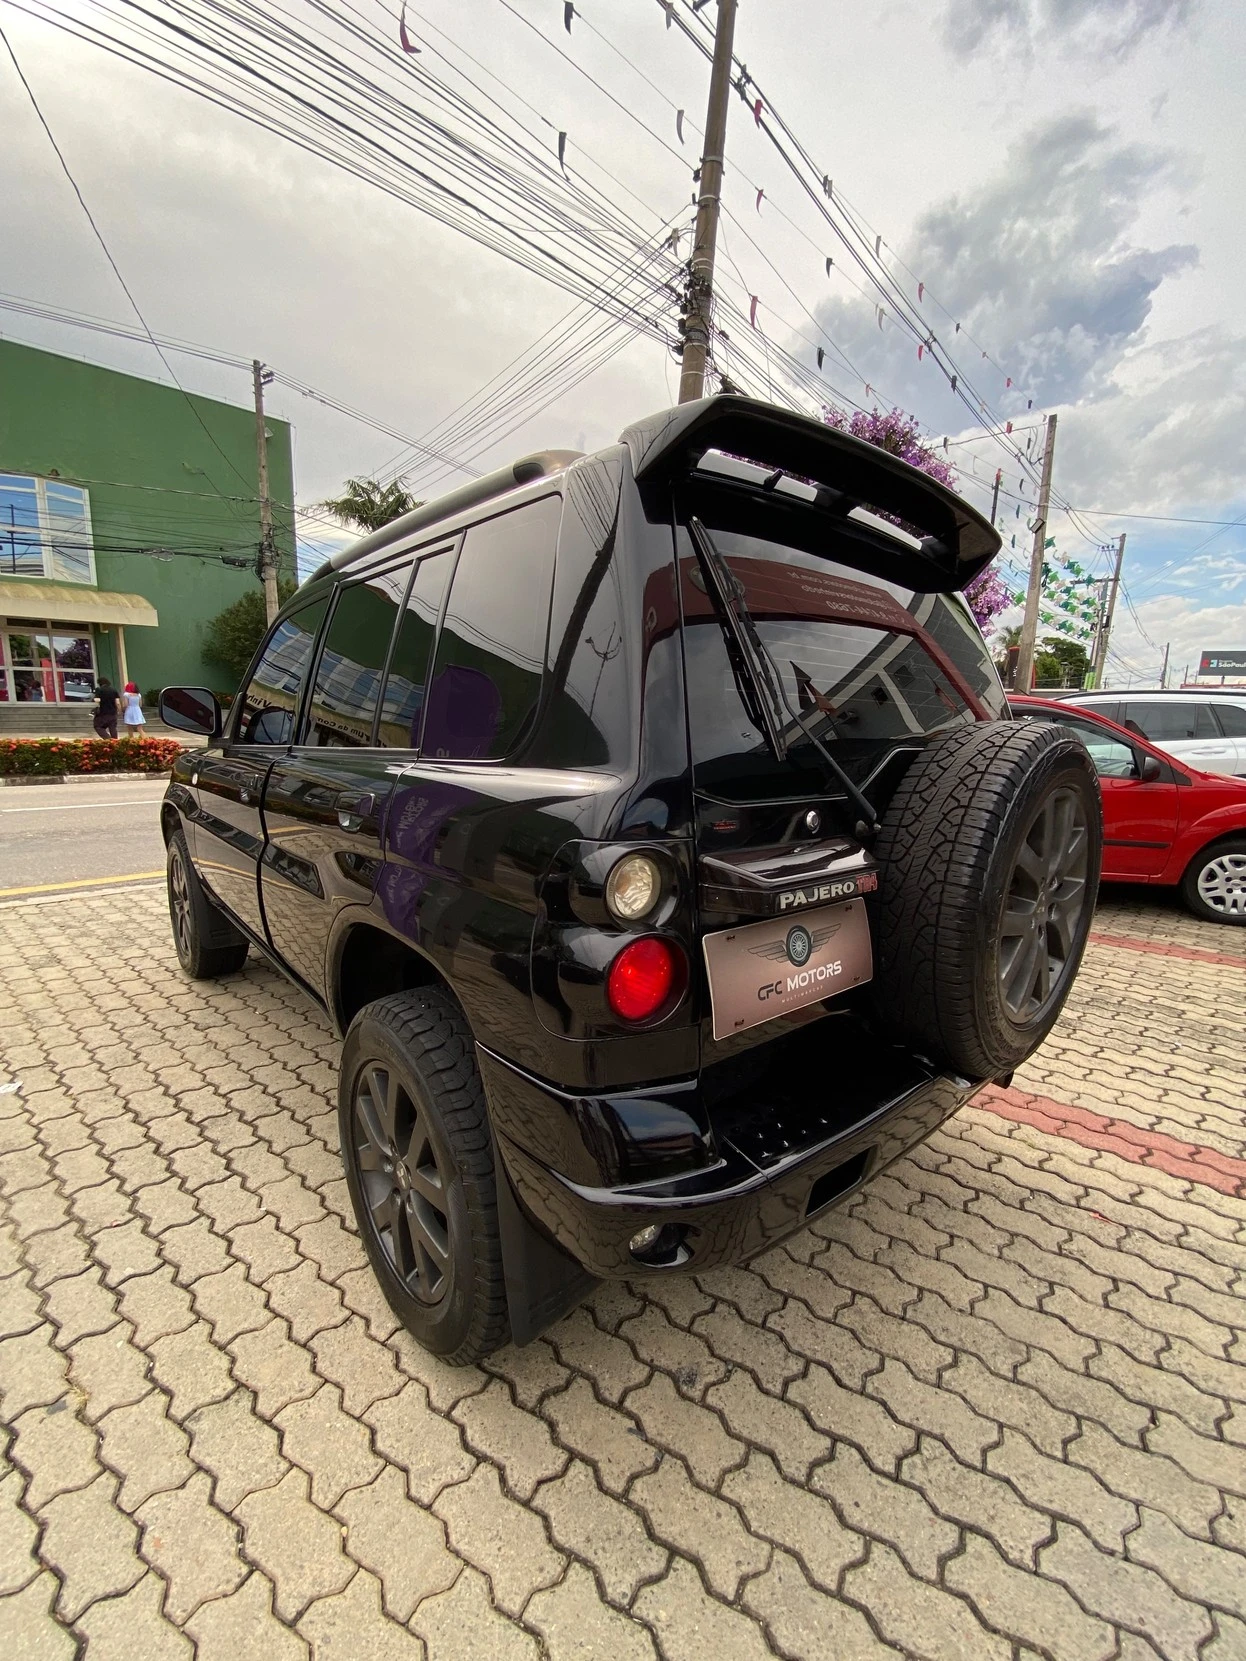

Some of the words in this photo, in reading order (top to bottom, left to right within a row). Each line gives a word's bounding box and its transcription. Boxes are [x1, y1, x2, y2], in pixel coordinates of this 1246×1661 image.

[779, 881, 855, 910] PAJERO
[757, 980, 783, 1001] CFC
[786, 960, 842, 992] MOTORS
